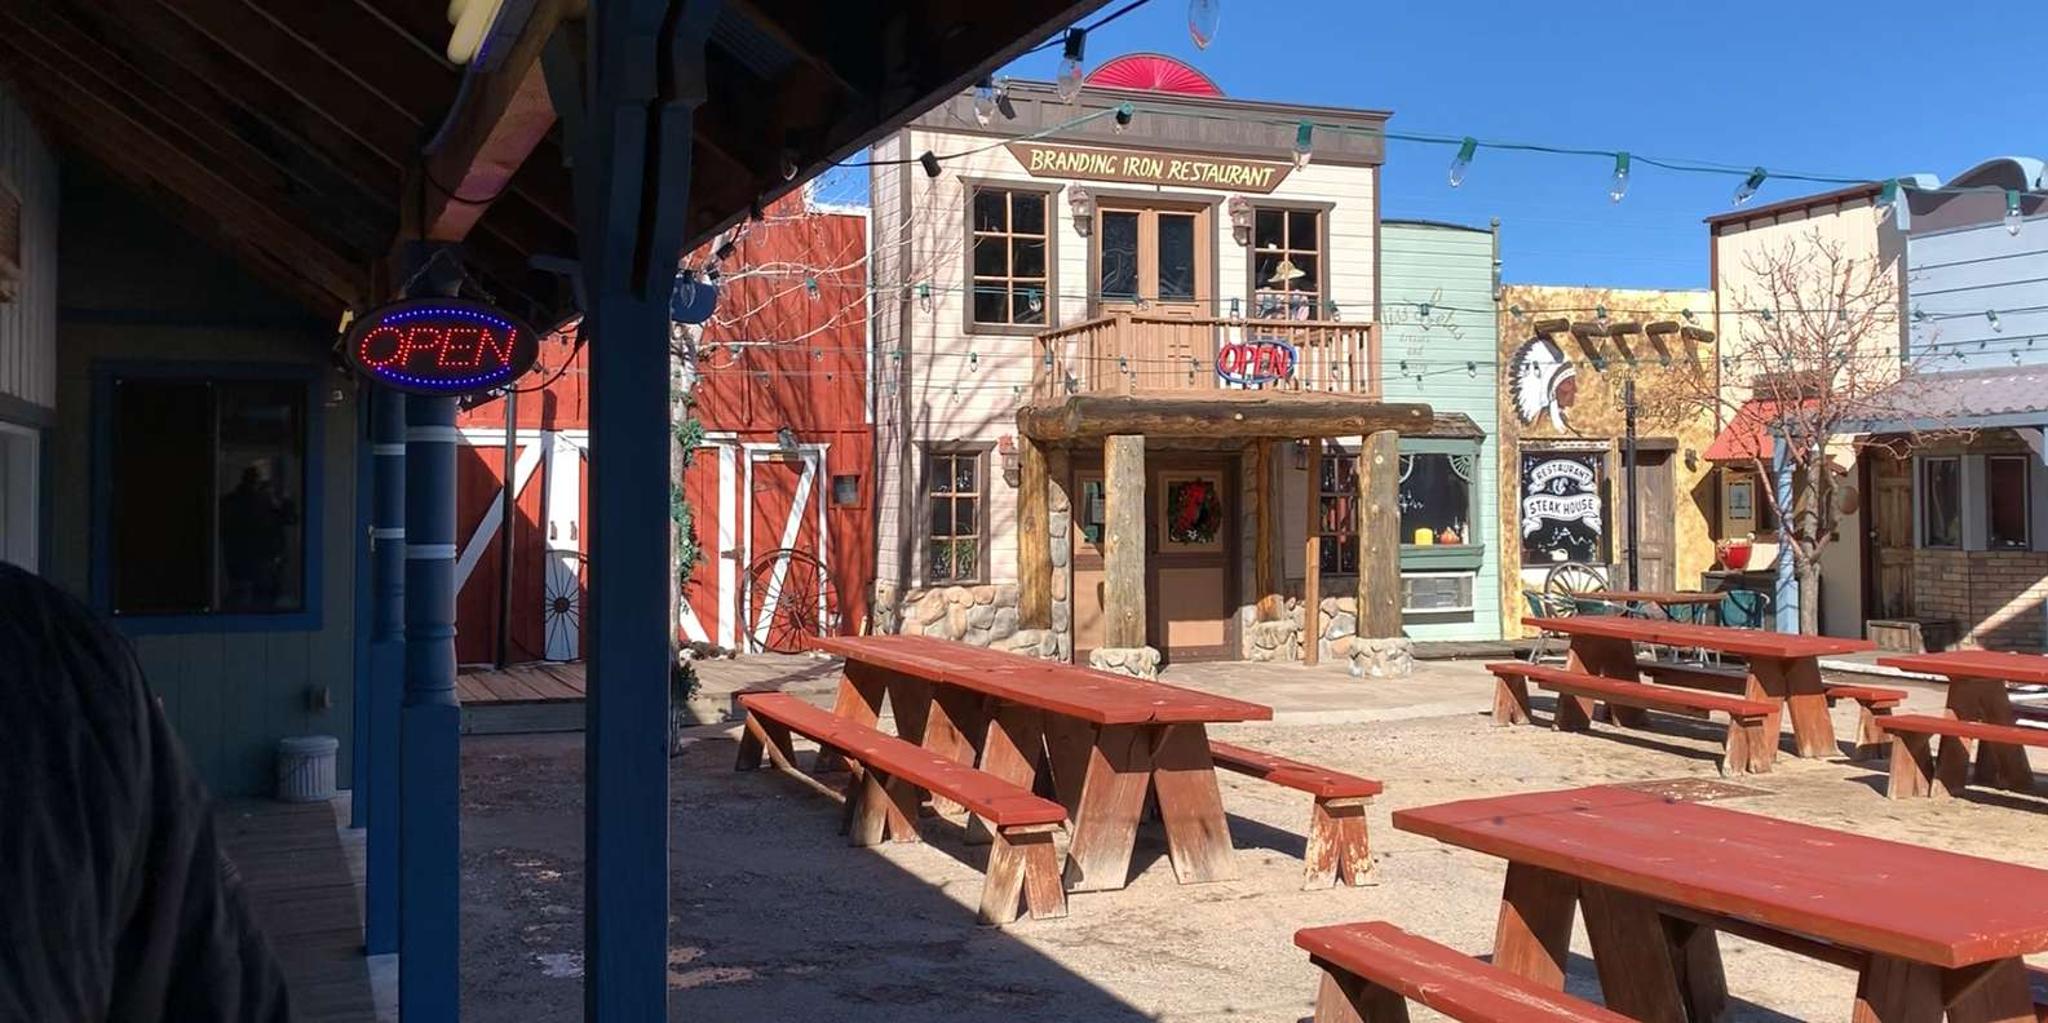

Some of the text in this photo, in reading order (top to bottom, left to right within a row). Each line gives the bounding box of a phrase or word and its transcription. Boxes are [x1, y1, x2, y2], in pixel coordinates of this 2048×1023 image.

[1030, 149, 1275, 187] BRANDING IRON RESTAURANT
[361, 325, 519, 367] OPEN
[1219, 342, 1290, 378] OPEN
[1535, 464, 1590, 481] RESTAURANT
[1529, 498, 1594, 515] STEAK HOUSE
